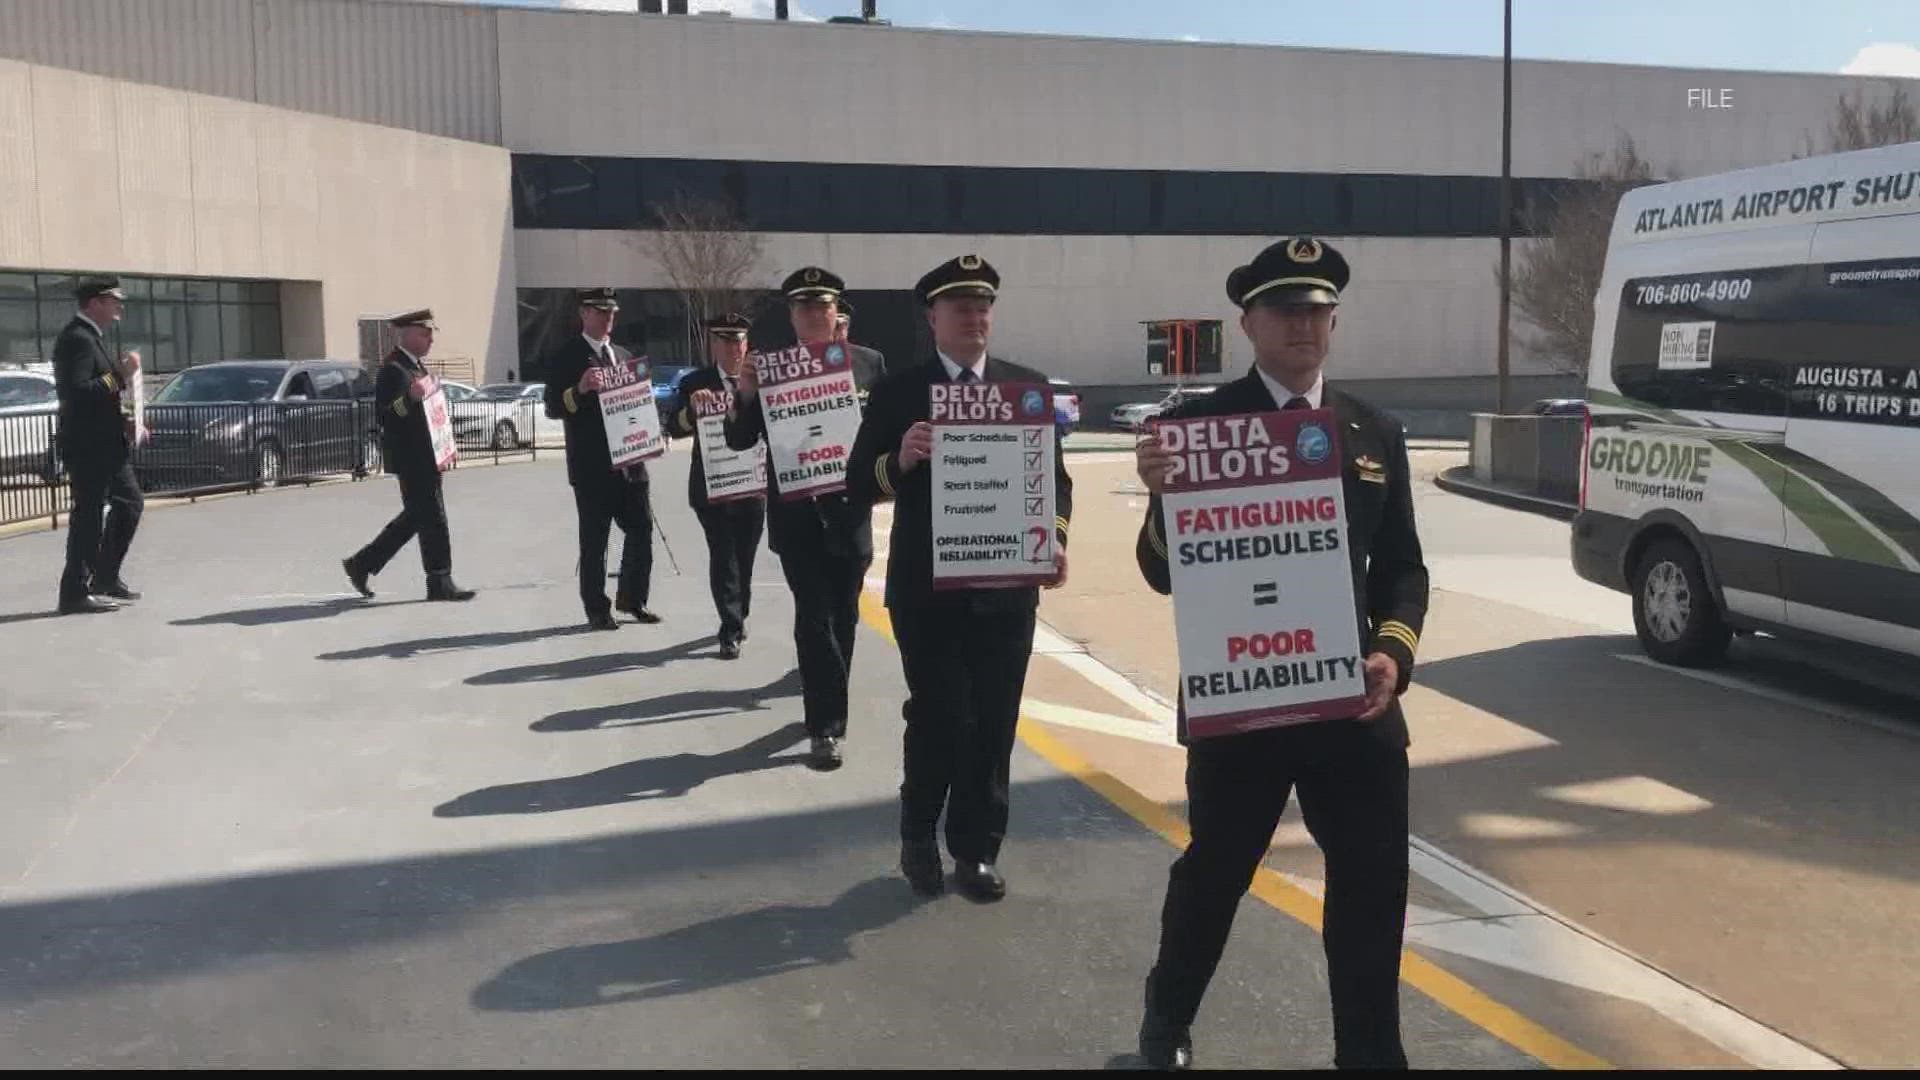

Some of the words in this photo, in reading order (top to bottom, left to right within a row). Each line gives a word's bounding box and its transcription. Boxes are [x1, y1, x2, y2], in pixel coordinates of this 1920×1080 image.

[1634, 198, 1723, 234] ATLANTA
[1732, 181, 1844, 221] AIRPORT
[1852, 171, 1920, 206] SHU
[1635, 278, 1751, 306] 706-860-4900
[755, 346, 812, 369] DELTA
[756, 359, 823, 385] PILOTS
[1795, 367, 1884, 389] AUGUSTA
[1904, 369, 1920, 389] A
[766, 379, 850, 407] FATIGUING
[931, 384, 1002, 402] DELTA
[1817, 393, 1837, 412] 16
[1844, 394, 1902, 415] TRIPS
[769, 396, 854, 422] SCHEDULES
[932, 403, 1013, 420] PILOTS
[943, 433, 967, 442] Poor
[968, 433, 1018, 442] Schedules
[1160, 417, 1270, 452] DELTA
[798, 445, 845, 465] POOR
[943, 454, 987, 466] Fatigued
[1164, 446, 1290, 485] PILOTS
[1590, 437, 1712, 484] GROOME
[779, 460, 848, 484] RELIABIL
[944, 480, 971, 491] Short
[974, 478, 1008, 490] Staffed
[1615, 476, 1703, 502] transportation
[944, 504, 996, 515] Frustrated
[1176, 496, 1336, 535] FATIGUING
[937, 534, 1020, 546] OPERATIONAL
[1179, 528, 1340, 566] SCHEDULES
[940, 549, 1017, 562] RELIABILITY?
[1227, 629, 1316, 663] POOR
[1188, 656, 1360, 699] RELIABILITY
